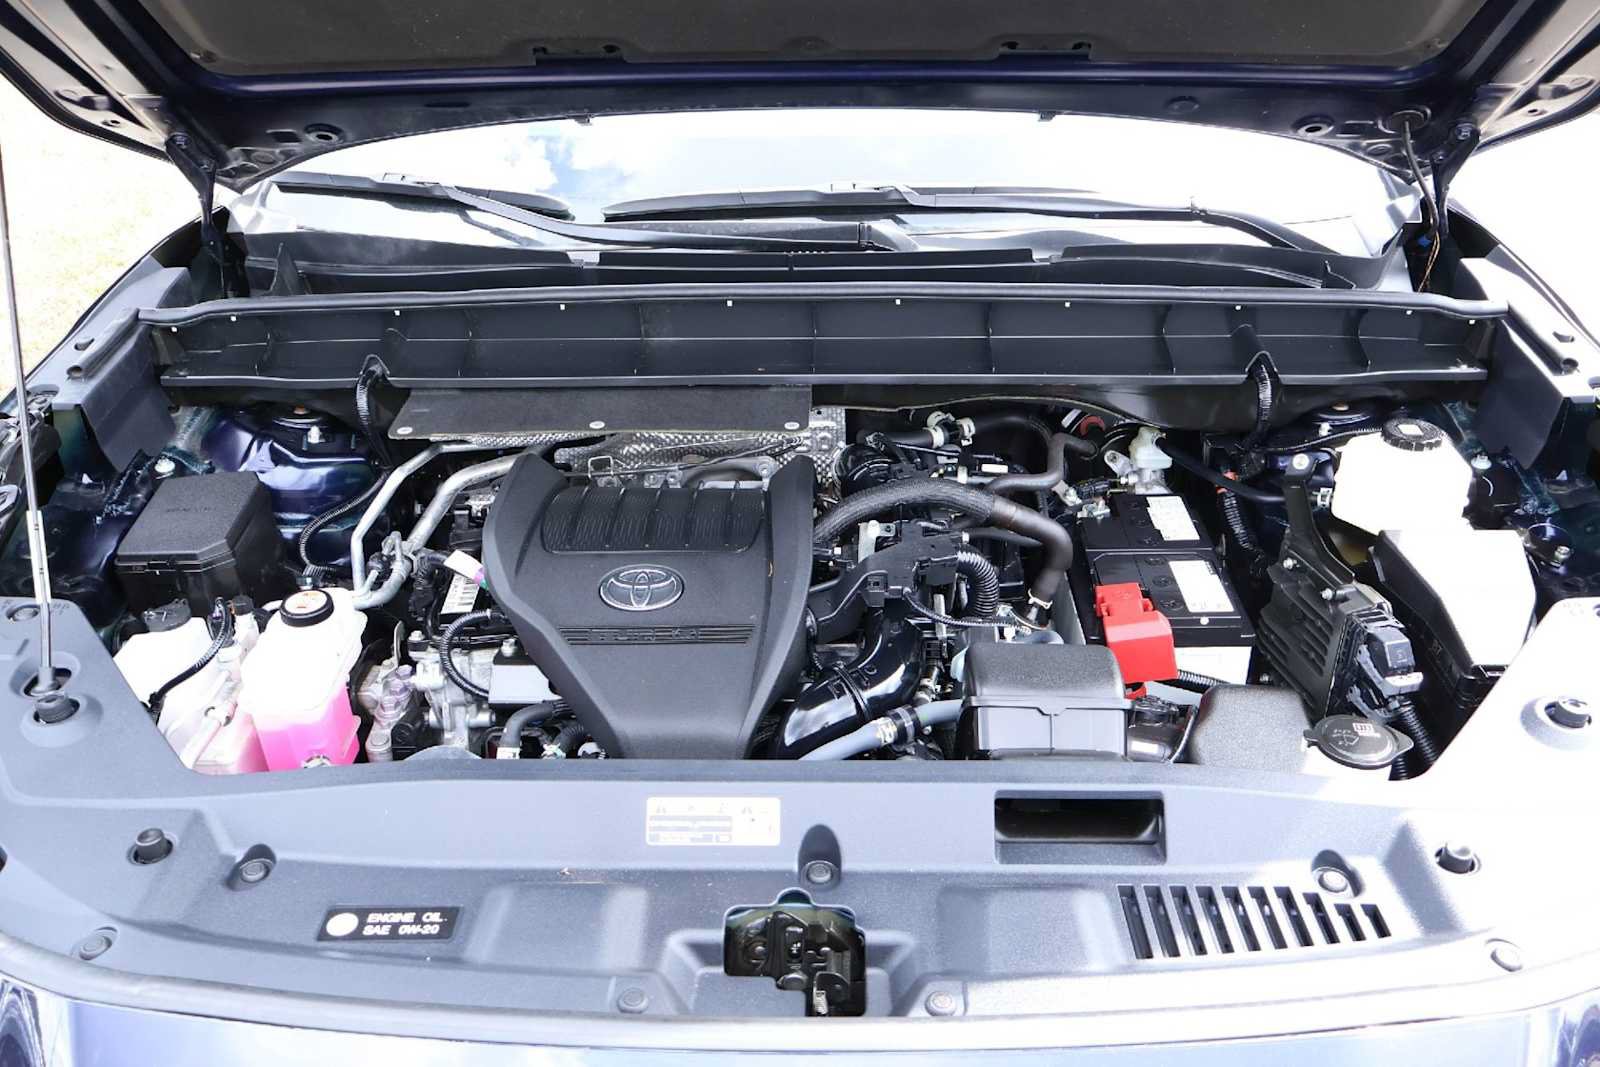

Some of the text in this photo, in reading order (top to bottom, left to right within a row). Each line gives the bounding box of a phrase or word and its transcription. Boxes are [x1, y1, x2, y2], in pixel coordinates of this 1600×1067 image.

[367, 912, 416, 923] ENGINE
[362, 924, 440, 935] SAE 0W-20
